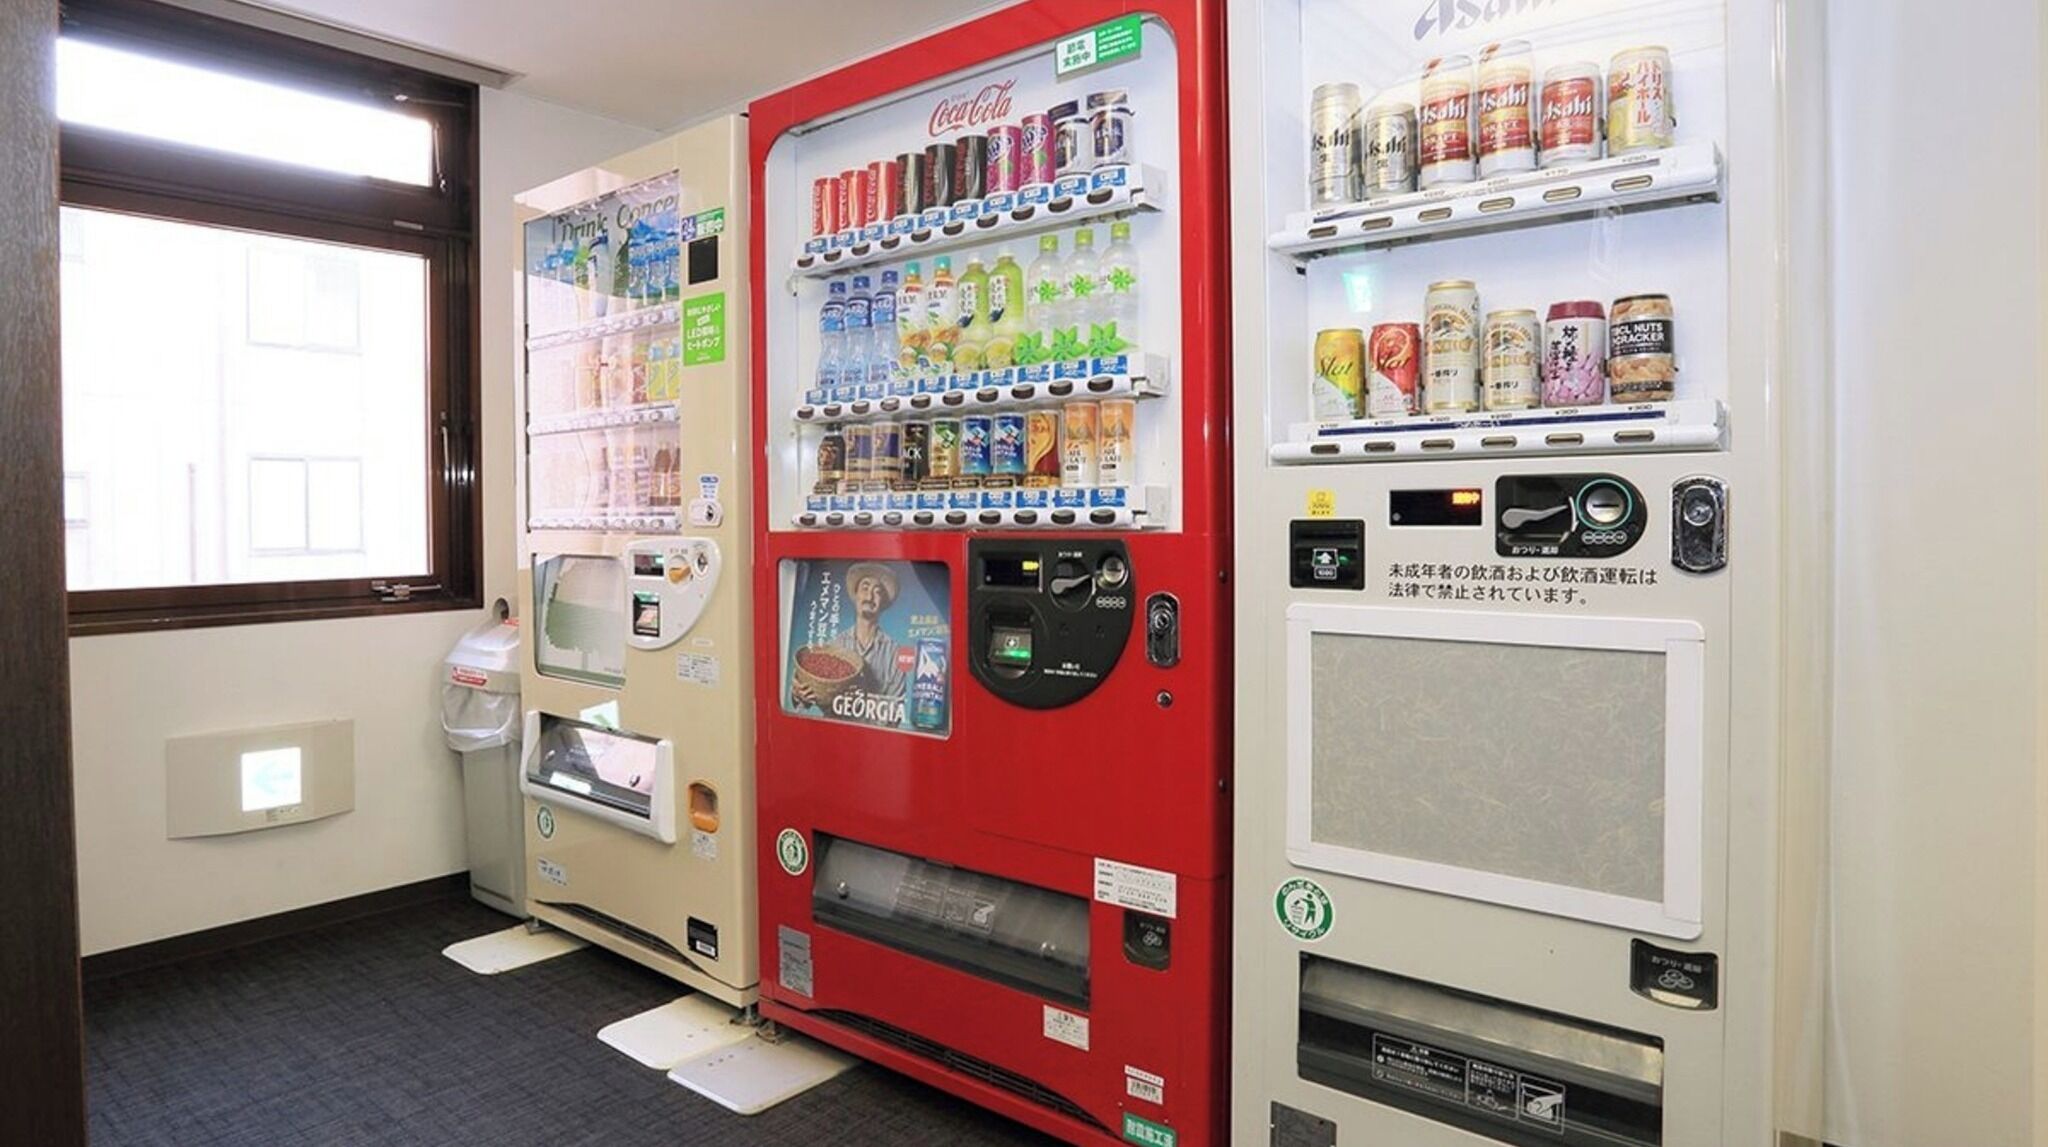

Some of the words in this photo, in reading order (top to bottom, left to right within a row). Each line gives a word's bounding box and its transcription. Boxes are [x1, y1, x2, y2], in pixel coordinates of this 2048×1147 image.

[1634, 322, 1663, 333] NUTS
[1388, 563, 1659, 585] 未成年者の飲酒および飲酒運転は
[1388, 582, 1587, 605] 法律で禁止されています。
[832, 692, 906, 723] GEORGIA
